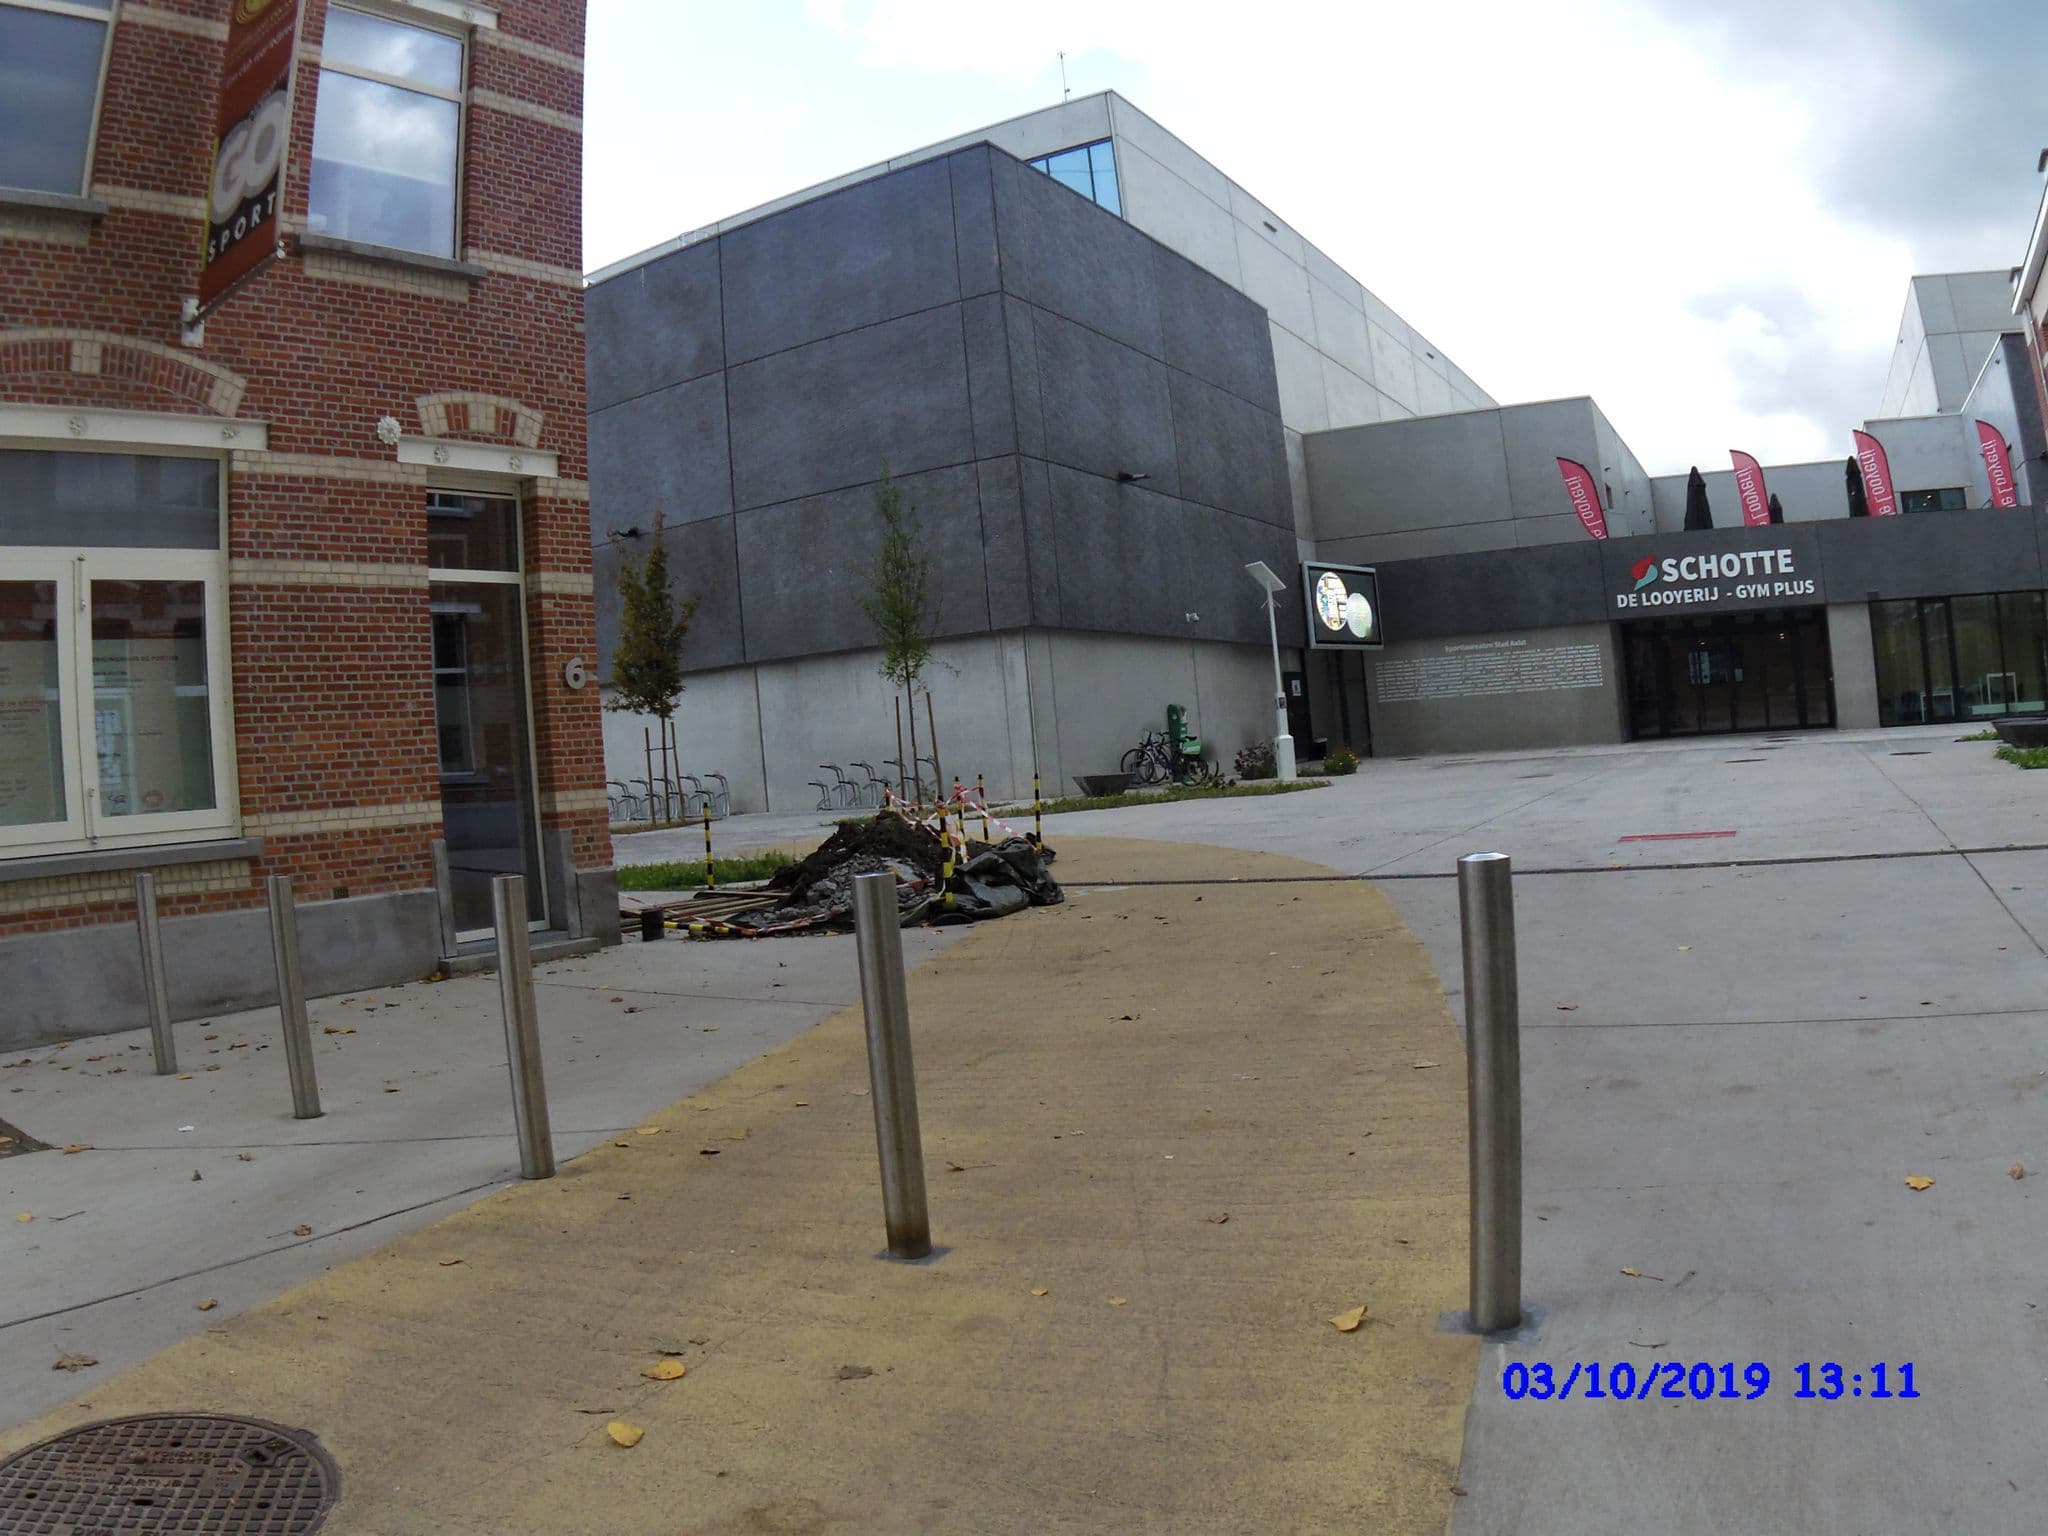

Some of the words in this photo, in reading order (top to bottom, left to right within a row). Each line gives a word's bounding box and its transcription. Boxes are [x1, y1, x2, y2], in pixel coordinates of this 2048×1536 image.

[208, 190, 277, 263] SPORT
[1661, 548, 1795, 583] SCHOTTE
[1616, 593, 1638, 608] DE
[1641, 587, 1719, 606] LOOYERIJ
[1735, 583, 1770, 599] GYM
[1773, 579, 1815, 597] PLUS
[565, 656, 586, 690] 6
